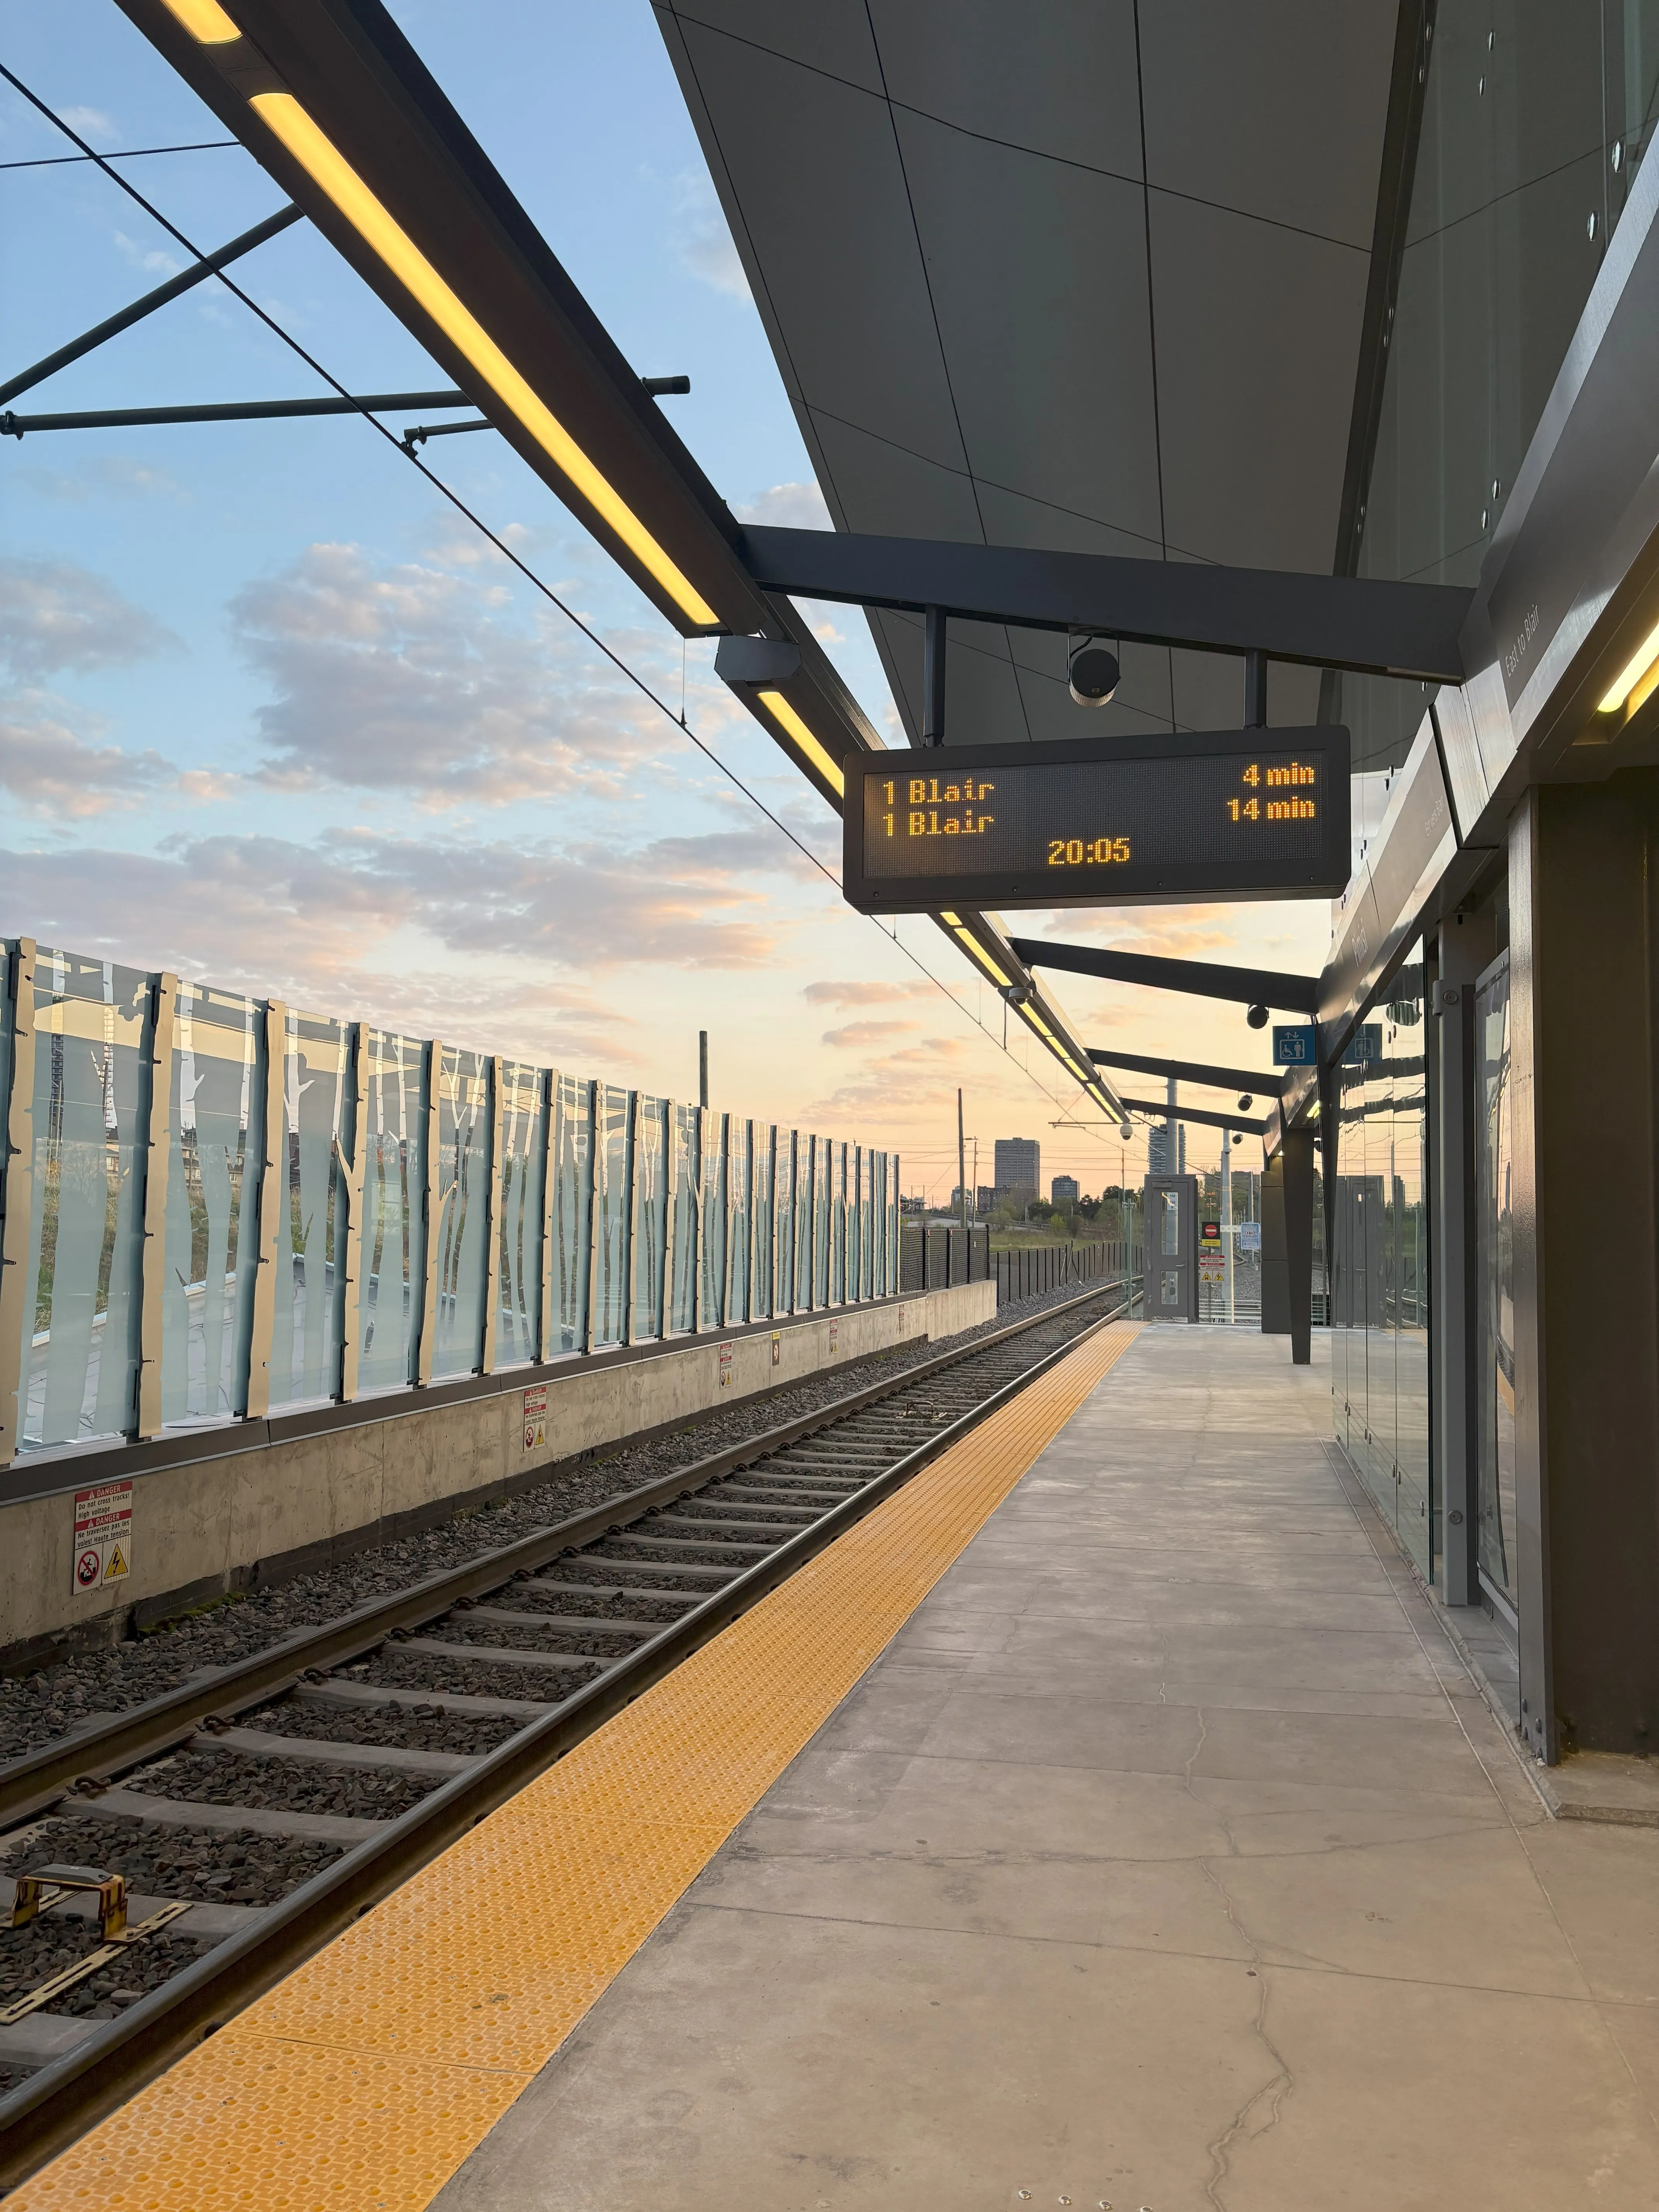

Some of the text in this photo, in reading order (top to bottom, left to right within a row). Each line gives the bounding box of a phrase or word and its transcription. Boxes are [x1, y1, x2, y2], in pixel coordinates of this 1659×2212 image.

[1505, 604, 1539, 678] East to Blair
[883, 762, 1315, 805] 1 Blair 4 min
[883, 796, 1315, 836] 1 Blair 14 min
[1048, 838, 1130, 865] 20:05
[1352, 917, 1368, 967] Pimisi
[97, 1485, 120, 1497] DANGER
[113, 1492, 129, 1502] tracks!
[78, 1506, 110, 1519] High voltage
[96, 1513, 120, 1525] DANGER
[77, 1529, 129, 1547] voies! Haute tension
[87, 1525, 110, 1536] traversez
[112, 1523, 120, 1531] pas
